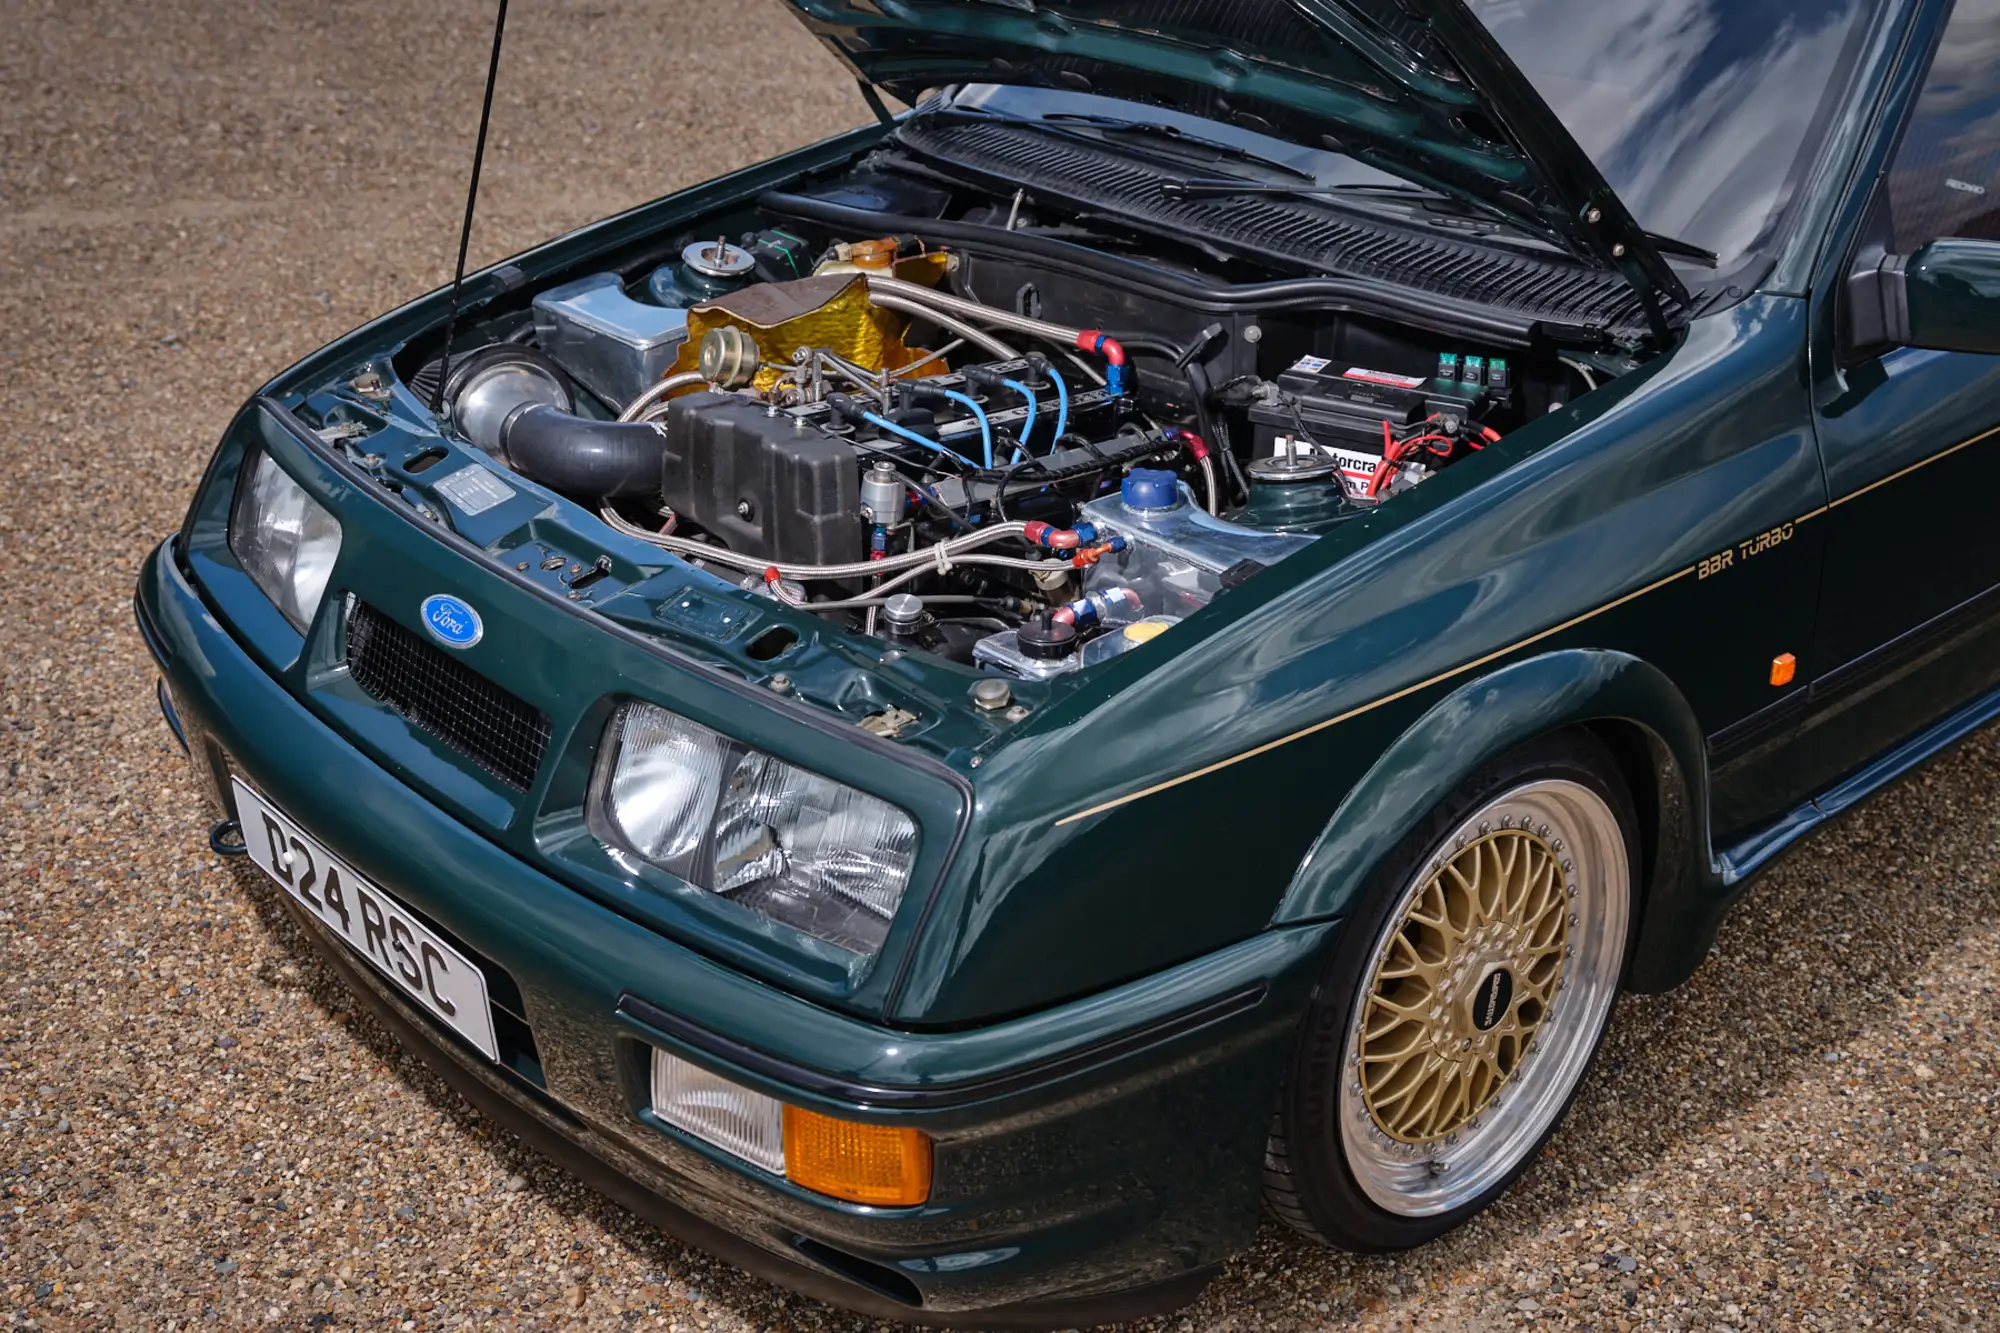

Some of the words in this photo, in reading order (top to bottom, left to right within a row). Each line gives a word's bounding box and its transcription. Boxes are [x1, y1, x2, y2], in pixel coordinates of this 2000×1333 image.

[1698, 549, 1734, 580] BBR
[1739, 522, 1793, 560] TURBO
[432, 602, 468, 635] Ford
[356, 886, 456, 1017] RSC
